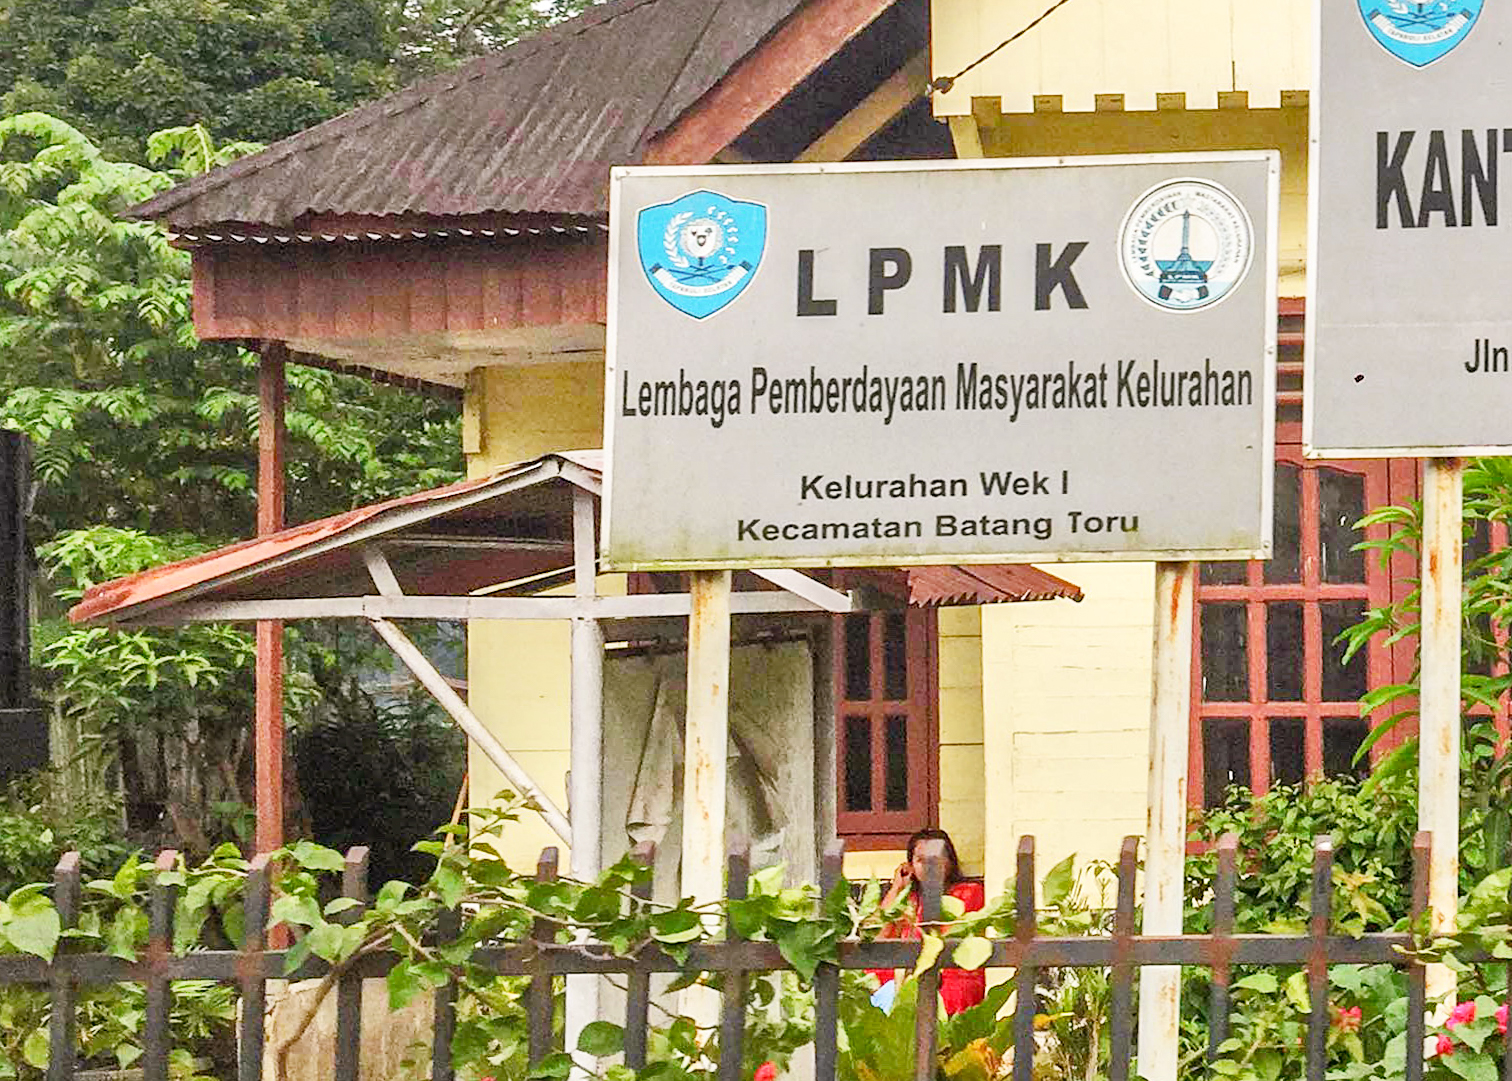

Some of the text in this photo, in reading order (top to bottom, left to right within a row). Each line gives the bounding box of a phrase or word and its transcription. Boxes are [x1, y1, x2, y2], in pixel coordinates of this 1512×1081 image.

[622, 358, 1252, 429] Lembaga Pemberdayaan Masyarakat Kelurahan
[801, 470, 1068, 500] Kelurahan Wek I
[737, 511, 1139, 542] Kecamatan Batang Toru
